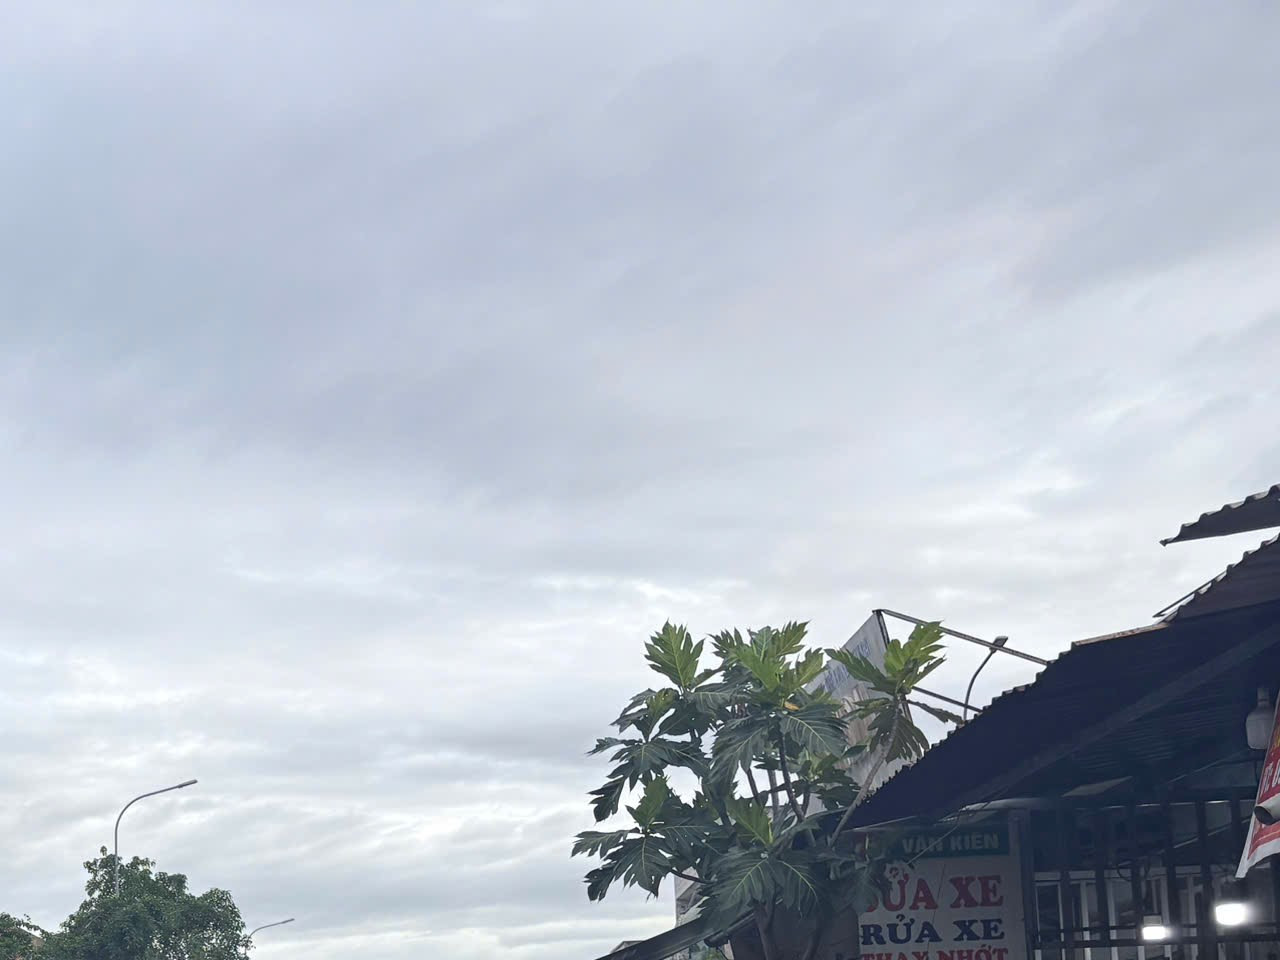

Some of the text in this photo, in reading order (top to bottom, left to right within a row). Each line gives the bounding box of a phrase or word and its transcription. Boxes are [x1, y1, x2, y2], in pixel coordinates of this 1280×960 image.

[949, 875, 1004, 909] XE
[860, 914, 1005, 946] RỬA XE
